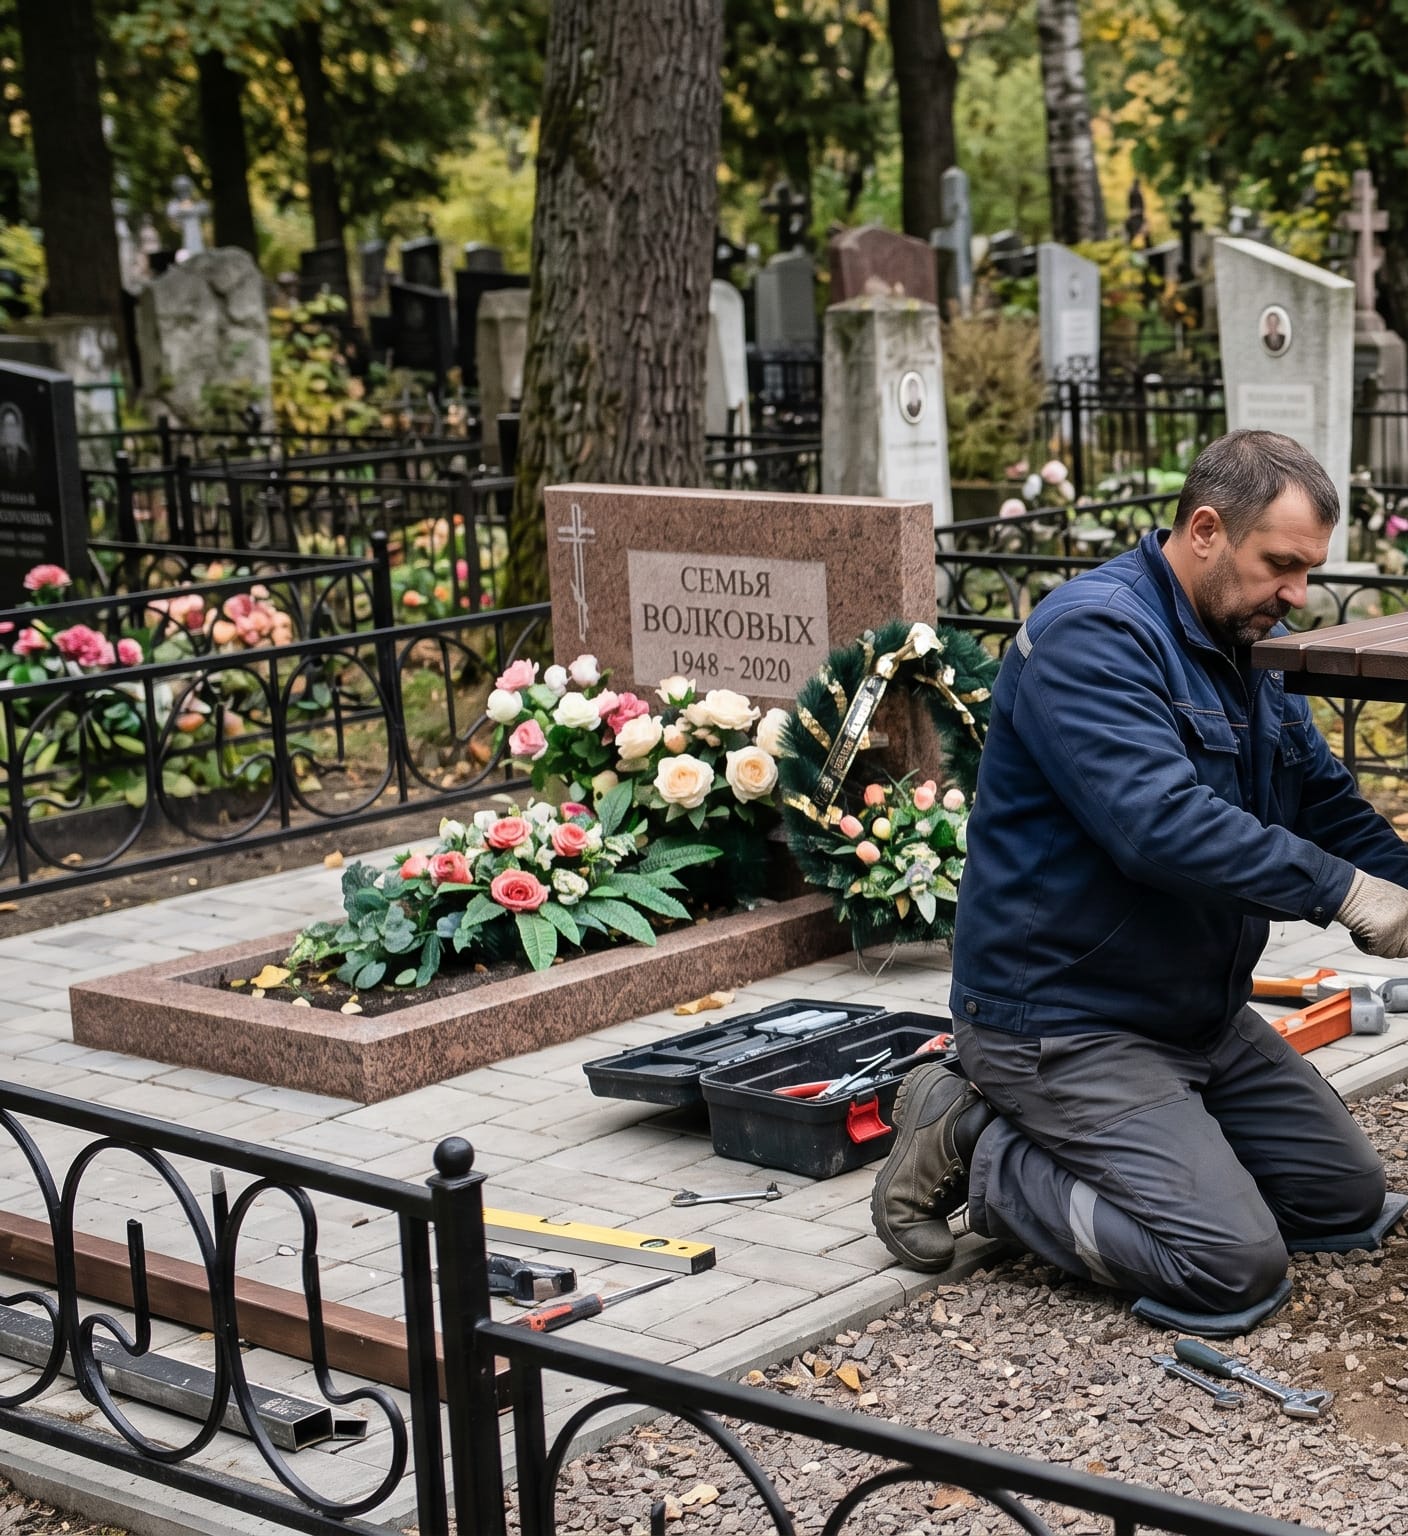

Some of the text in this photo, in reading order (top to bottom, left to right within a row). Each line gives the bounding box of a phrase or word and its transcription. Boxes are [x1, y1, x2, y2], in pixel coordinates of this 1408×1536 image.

[680, 566, 771, 598] СЕМЬЯ
[642, 604, 816, 646] ВОЛКОВЫХ
[671, 650, 720, 677] 1948
[739, 656, 791, 683] 2020
